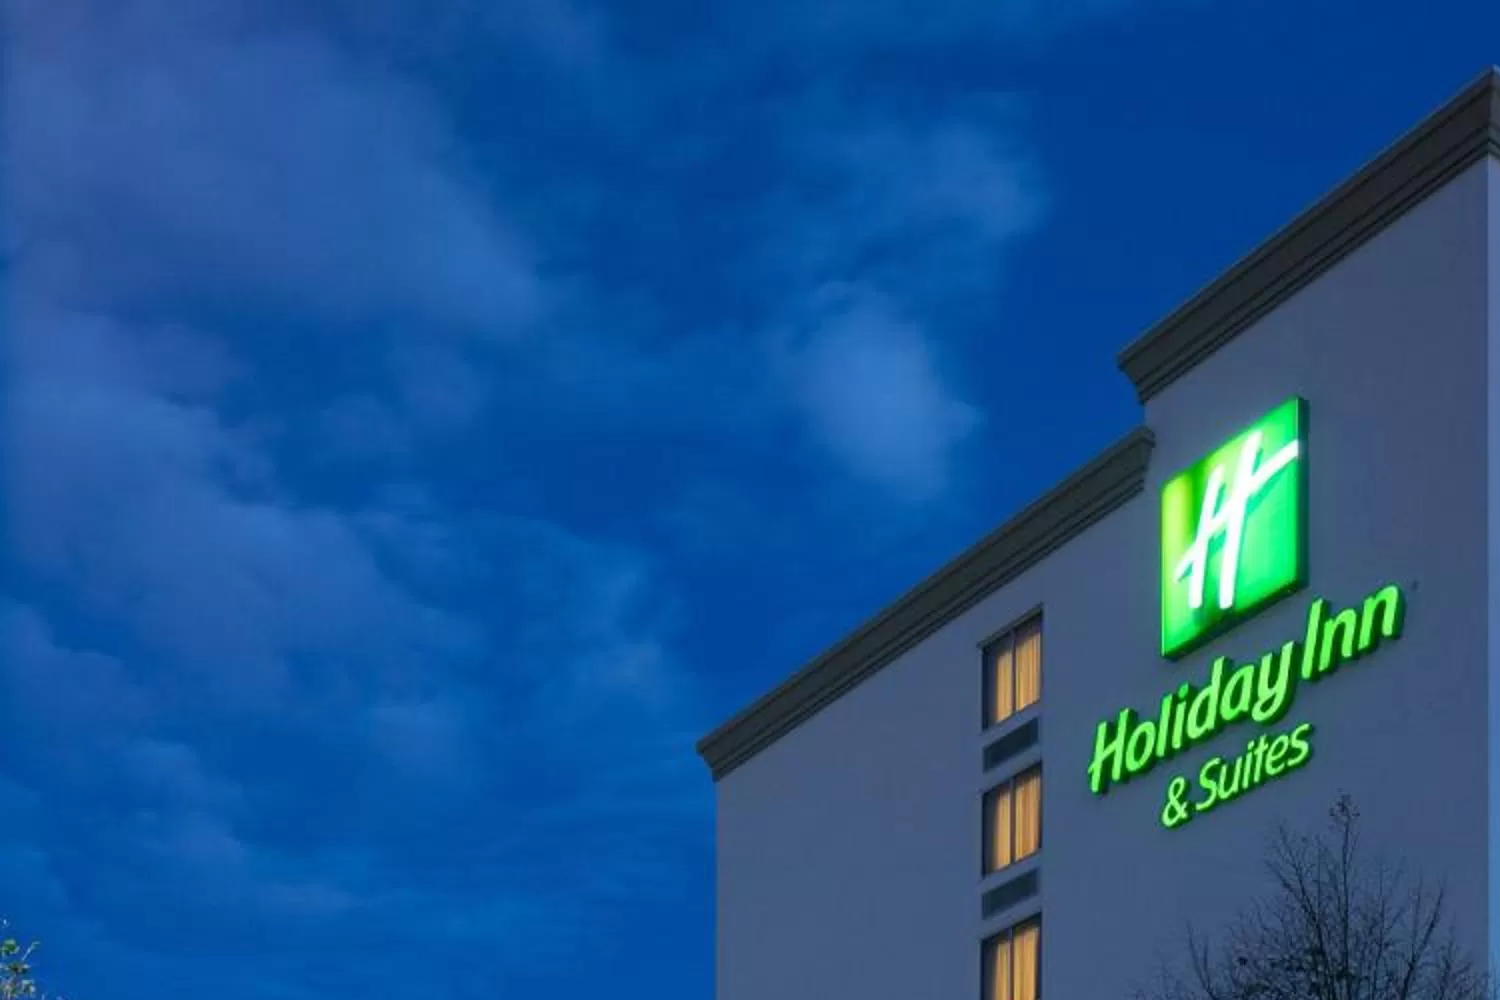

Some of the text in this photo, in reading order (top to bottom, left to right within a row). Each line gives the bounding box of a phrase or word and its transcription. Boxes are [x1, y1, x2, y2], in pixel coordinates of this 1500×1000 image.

[1089, 584, 1401, 794] Holiday Inn
[1161, 723, 1312, 828] & Suites
